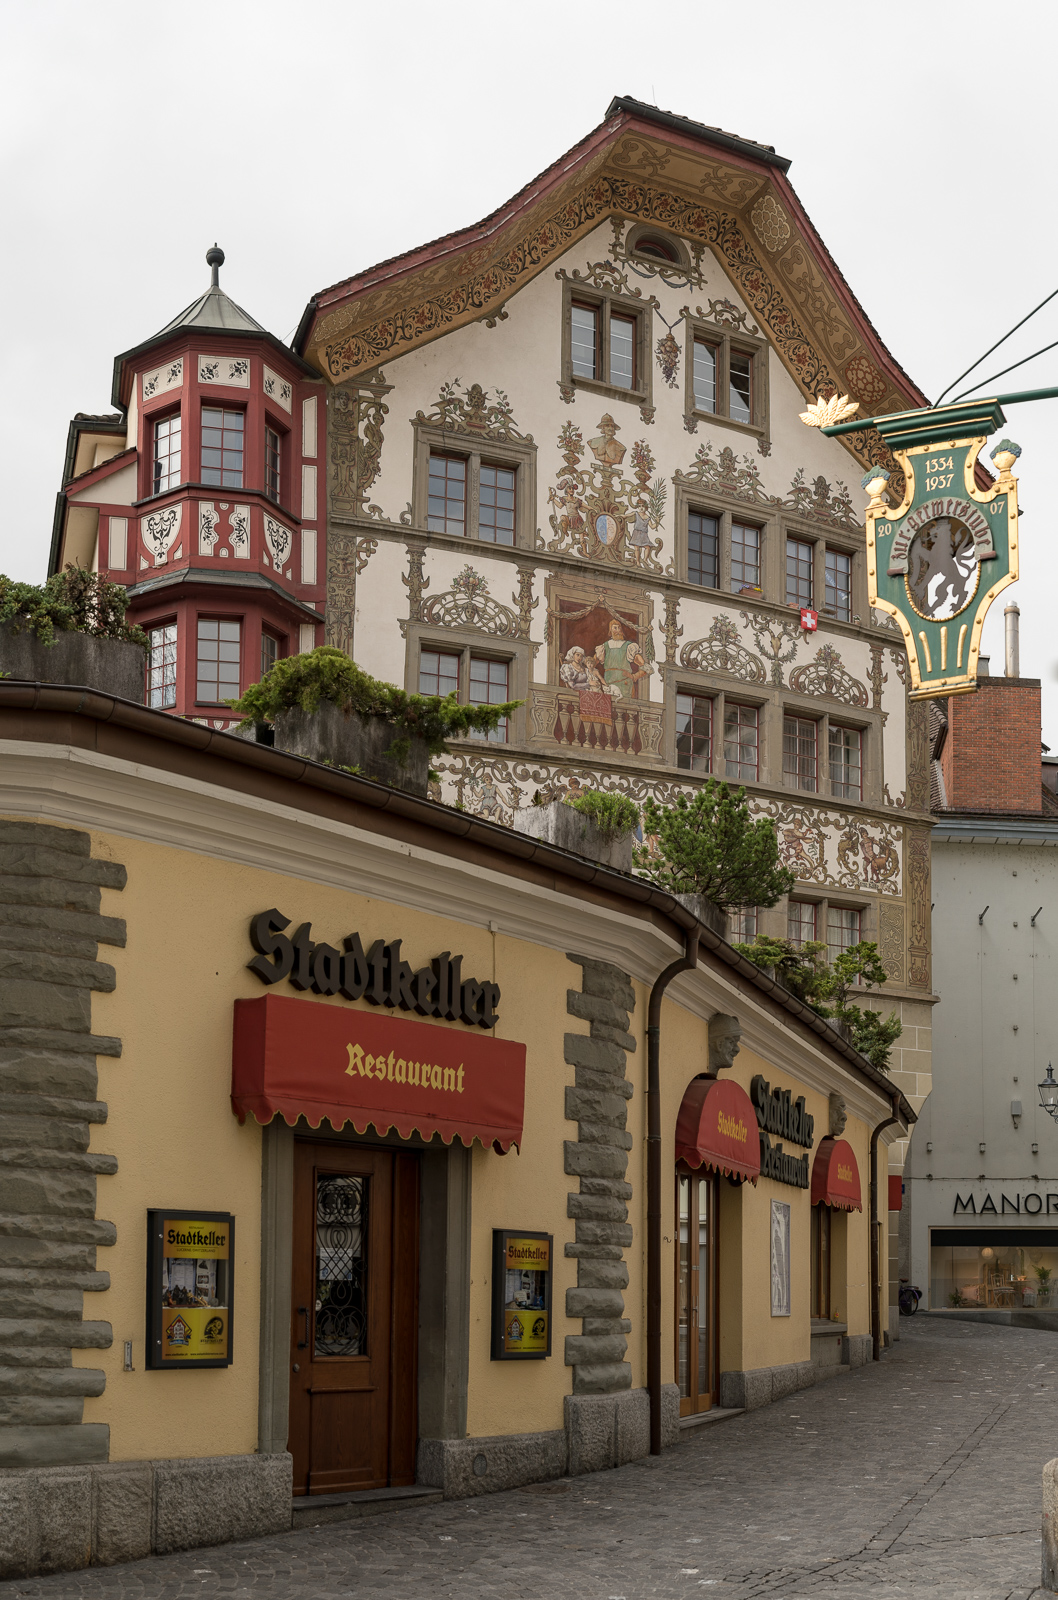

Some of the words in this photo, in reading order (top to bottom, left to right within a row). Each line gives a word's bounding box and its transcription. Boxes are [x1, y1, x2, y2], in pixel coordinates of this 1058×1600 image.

[925, 456, 954, 474] 1334
[925, 473, 954, 492] 1937
[878, 523, 892, 537] 20
[989, 501, 1005, 515] 07
[246, 908, 501, 1029] Stadtkeller
[345, 1042, 465, 1093] Restaurant
[751, 1074, 814, 1149] Stadtkeller
[717, 1110, 748, 1143] Stadtkeller
[953, 1193, 1058, 1214] MANOR
[167, 1229, 226, 1246] Stadtkeller
[508, 1245, 547, 1260] Stadtkeller
